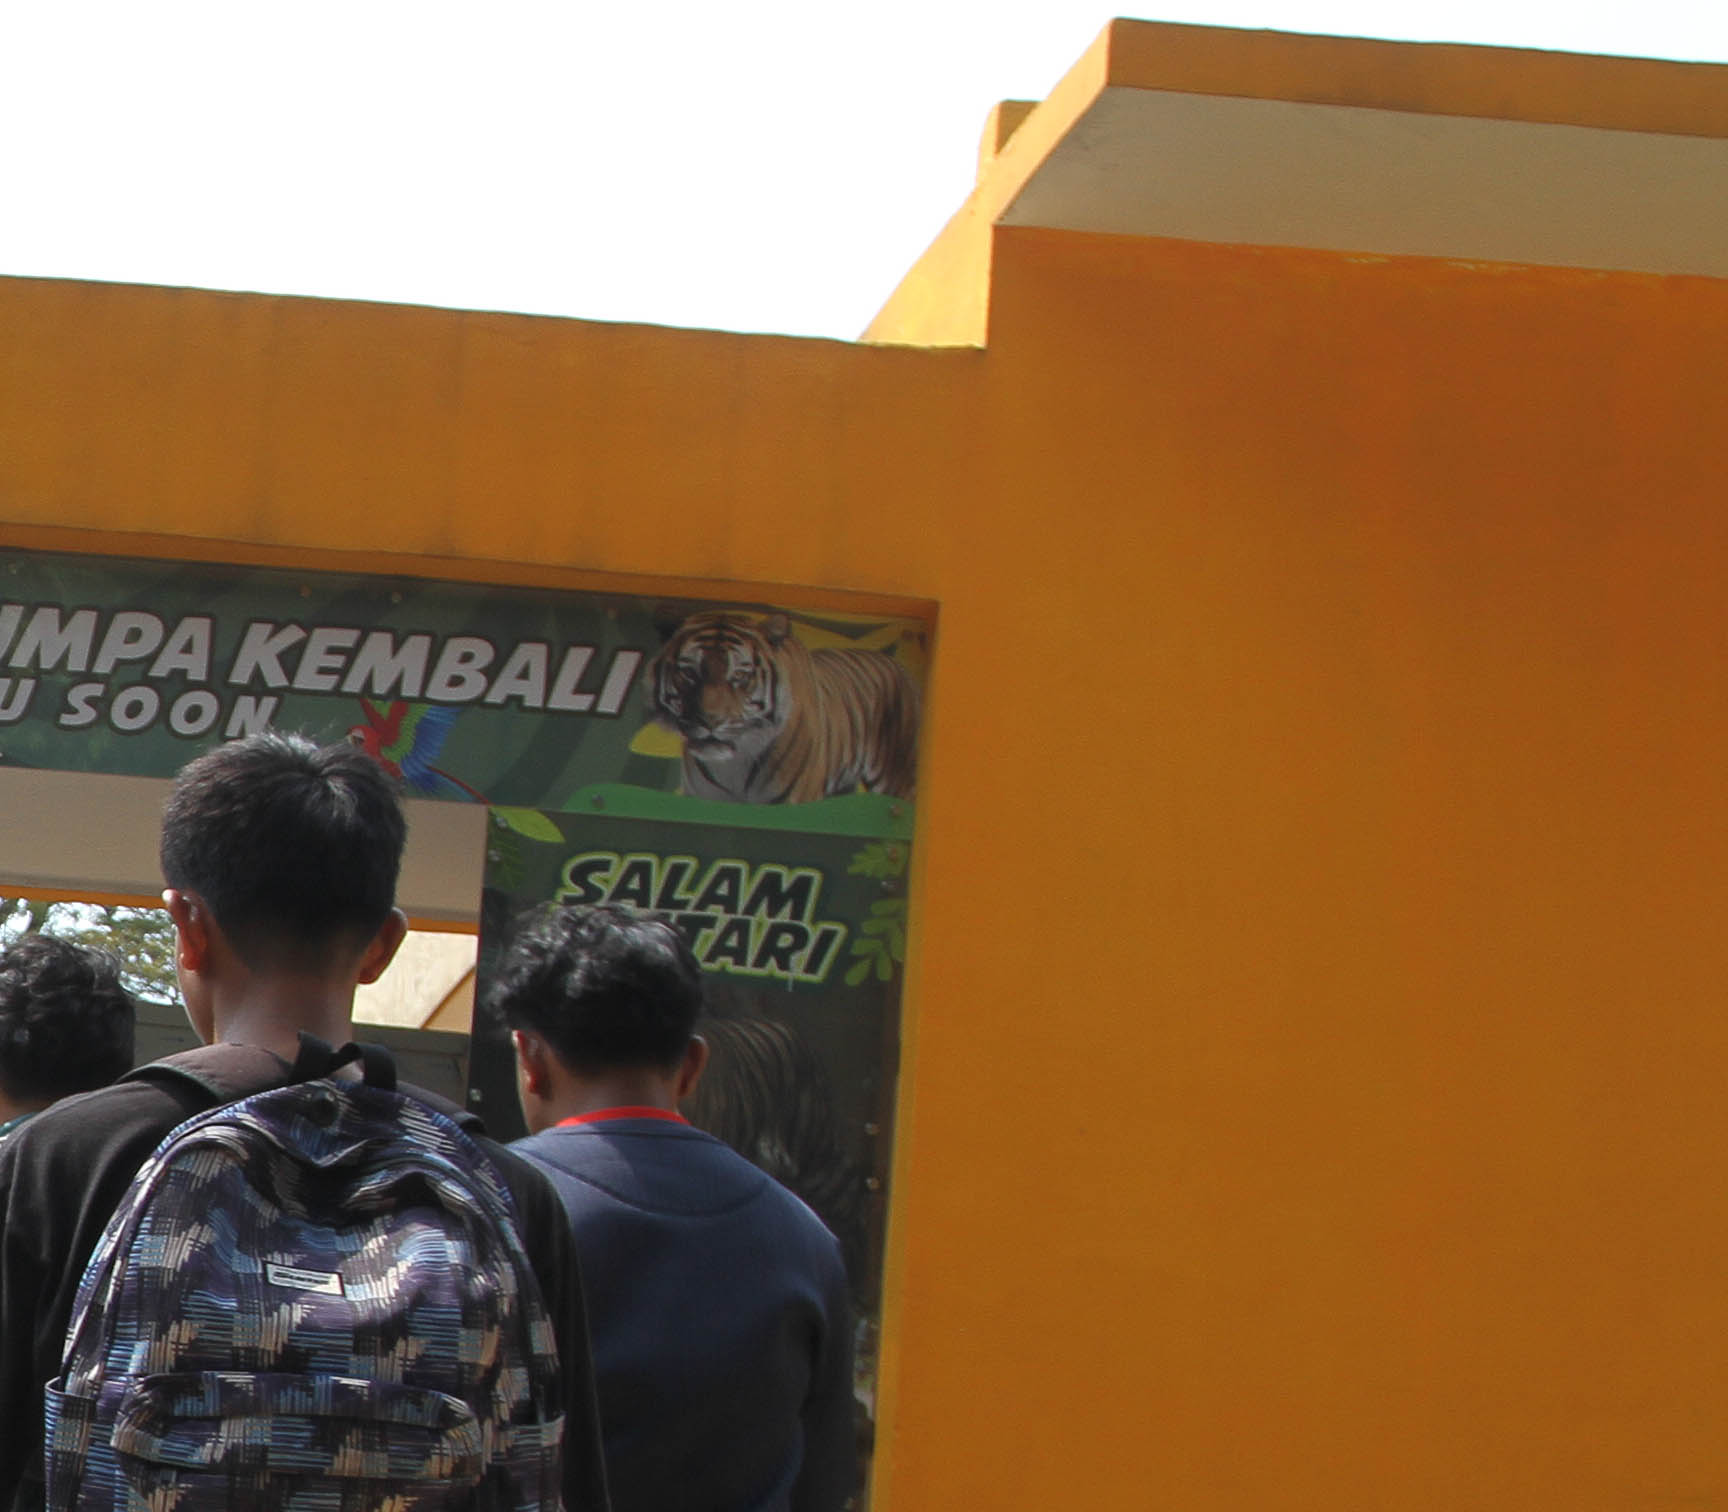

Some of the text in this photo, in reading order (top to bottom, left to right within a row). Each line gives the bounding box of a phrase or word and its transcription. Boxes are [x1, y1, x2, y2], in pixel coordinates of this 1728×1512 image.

[229, 621, 641, 715] KEMBALI
[59, 682, 279, 738] SOON
[558, 854, 820, 922] SALAM
[672, 911, 836, 976] TARI
